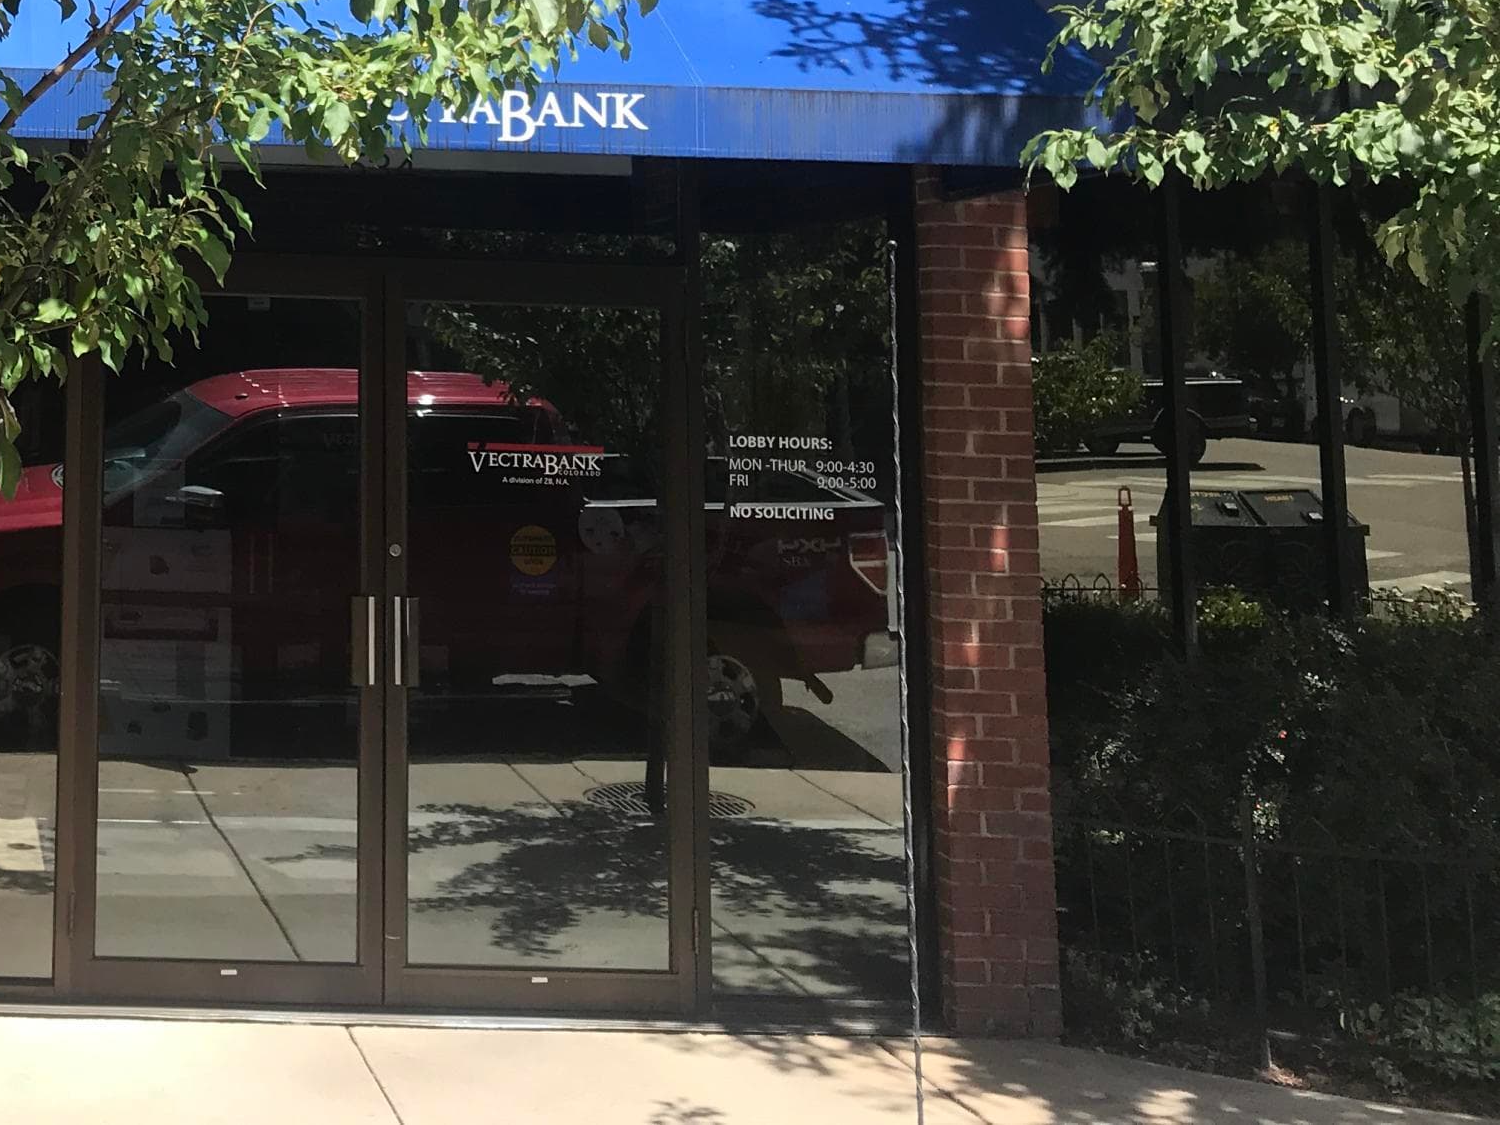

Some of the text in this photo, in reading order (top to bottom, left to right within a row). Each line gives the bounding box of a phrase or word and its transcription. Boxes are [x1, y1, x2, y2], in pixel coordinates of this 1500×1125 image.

[729, 435, 833, 450] LOBBY HOURS:
[729, 458, 762, 471] MON
[815, 461, 875, 474] 9:00-4:30
[729, 474, 877, 489] FRI 9:00-5:00
[730, 506, 835, 520] NO SOLICITING
